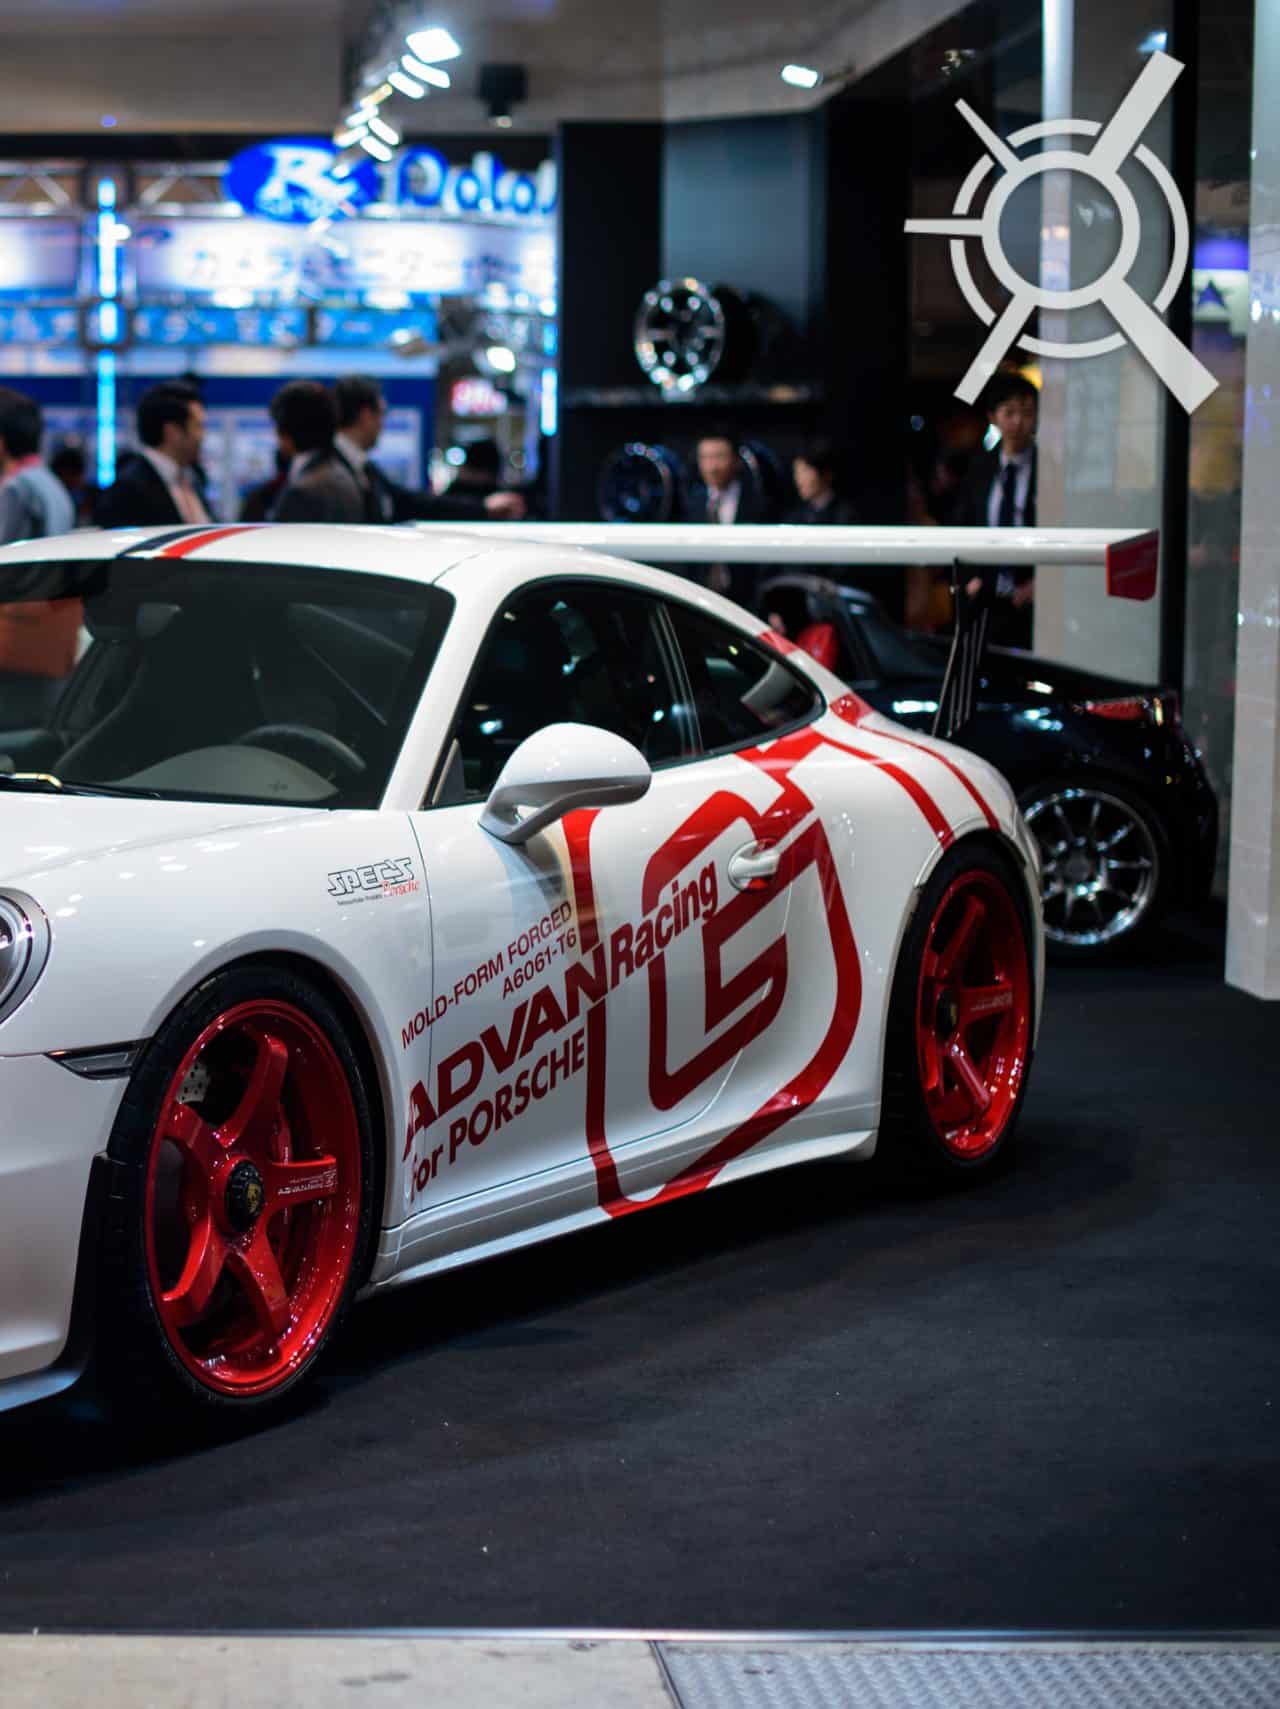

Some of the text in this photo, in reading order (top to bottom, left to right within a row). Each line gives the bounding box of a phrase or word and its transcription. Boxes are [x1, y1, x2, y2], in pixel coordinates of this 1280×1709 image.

[400, 900, 572, 1049] MOLD-FORM FORGED
[502, 928, 577, 999] A6061-T6
[449, 1027, 584, 1165] PORSCHE
